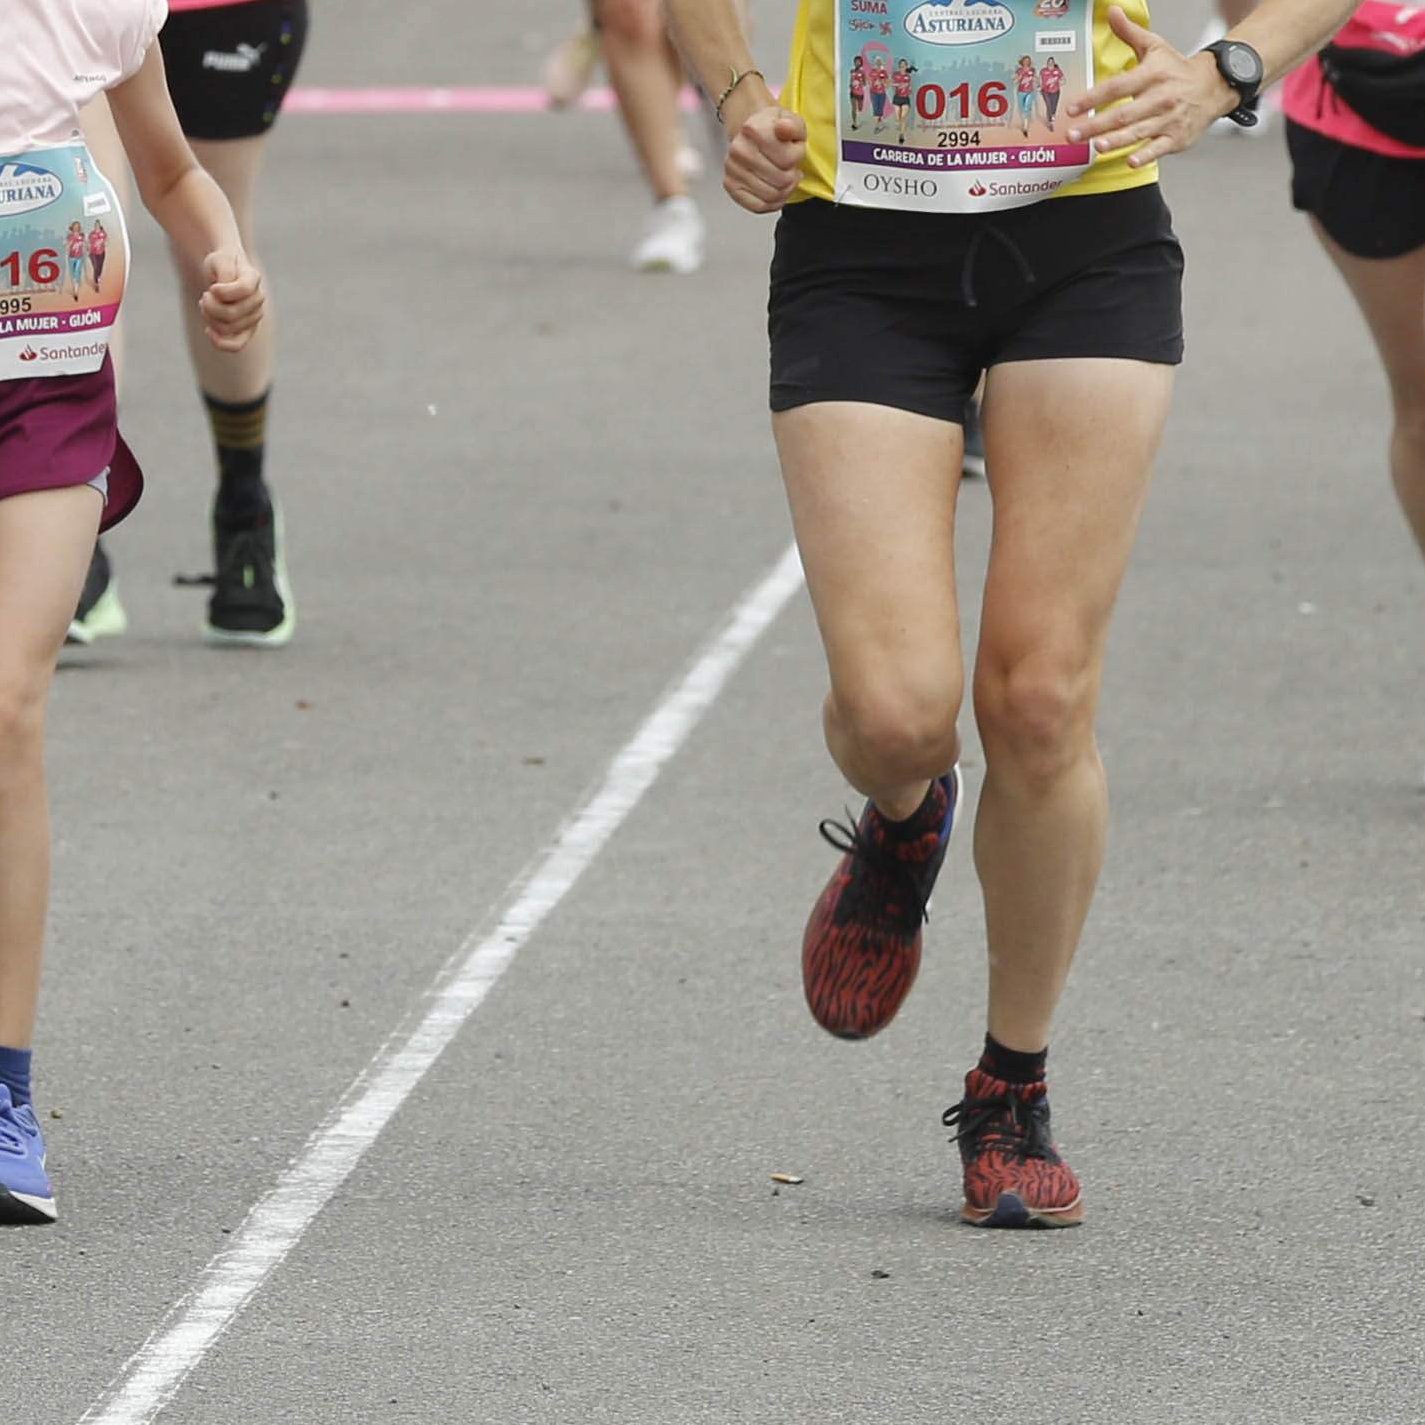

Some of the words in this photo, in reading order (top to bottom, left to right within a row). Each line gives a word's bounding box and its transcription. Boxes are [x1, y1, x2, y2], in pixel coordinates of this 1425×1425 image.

[851, 0, 888, 15] SUMA
[912, 12, 1006, 34] ASTURIANA
[916, 80, 1009, 120] 016
[937, 130, 981, 148] 2994
[873, 147, 924, 165] CARRERA
[927, 153, 944, 166] DE
[947, 152, 964, 166] LA
[965, 150, 1008, 165] MUJER
[1018, 147, 1055, 163] GIJÓN
[863, 173, 938, 197] OYSHO
[989, 179, 1063, 196] Santander
[18, 317, 59, 332] MUJER
[69, 310, 102, 328] GIJÓN
